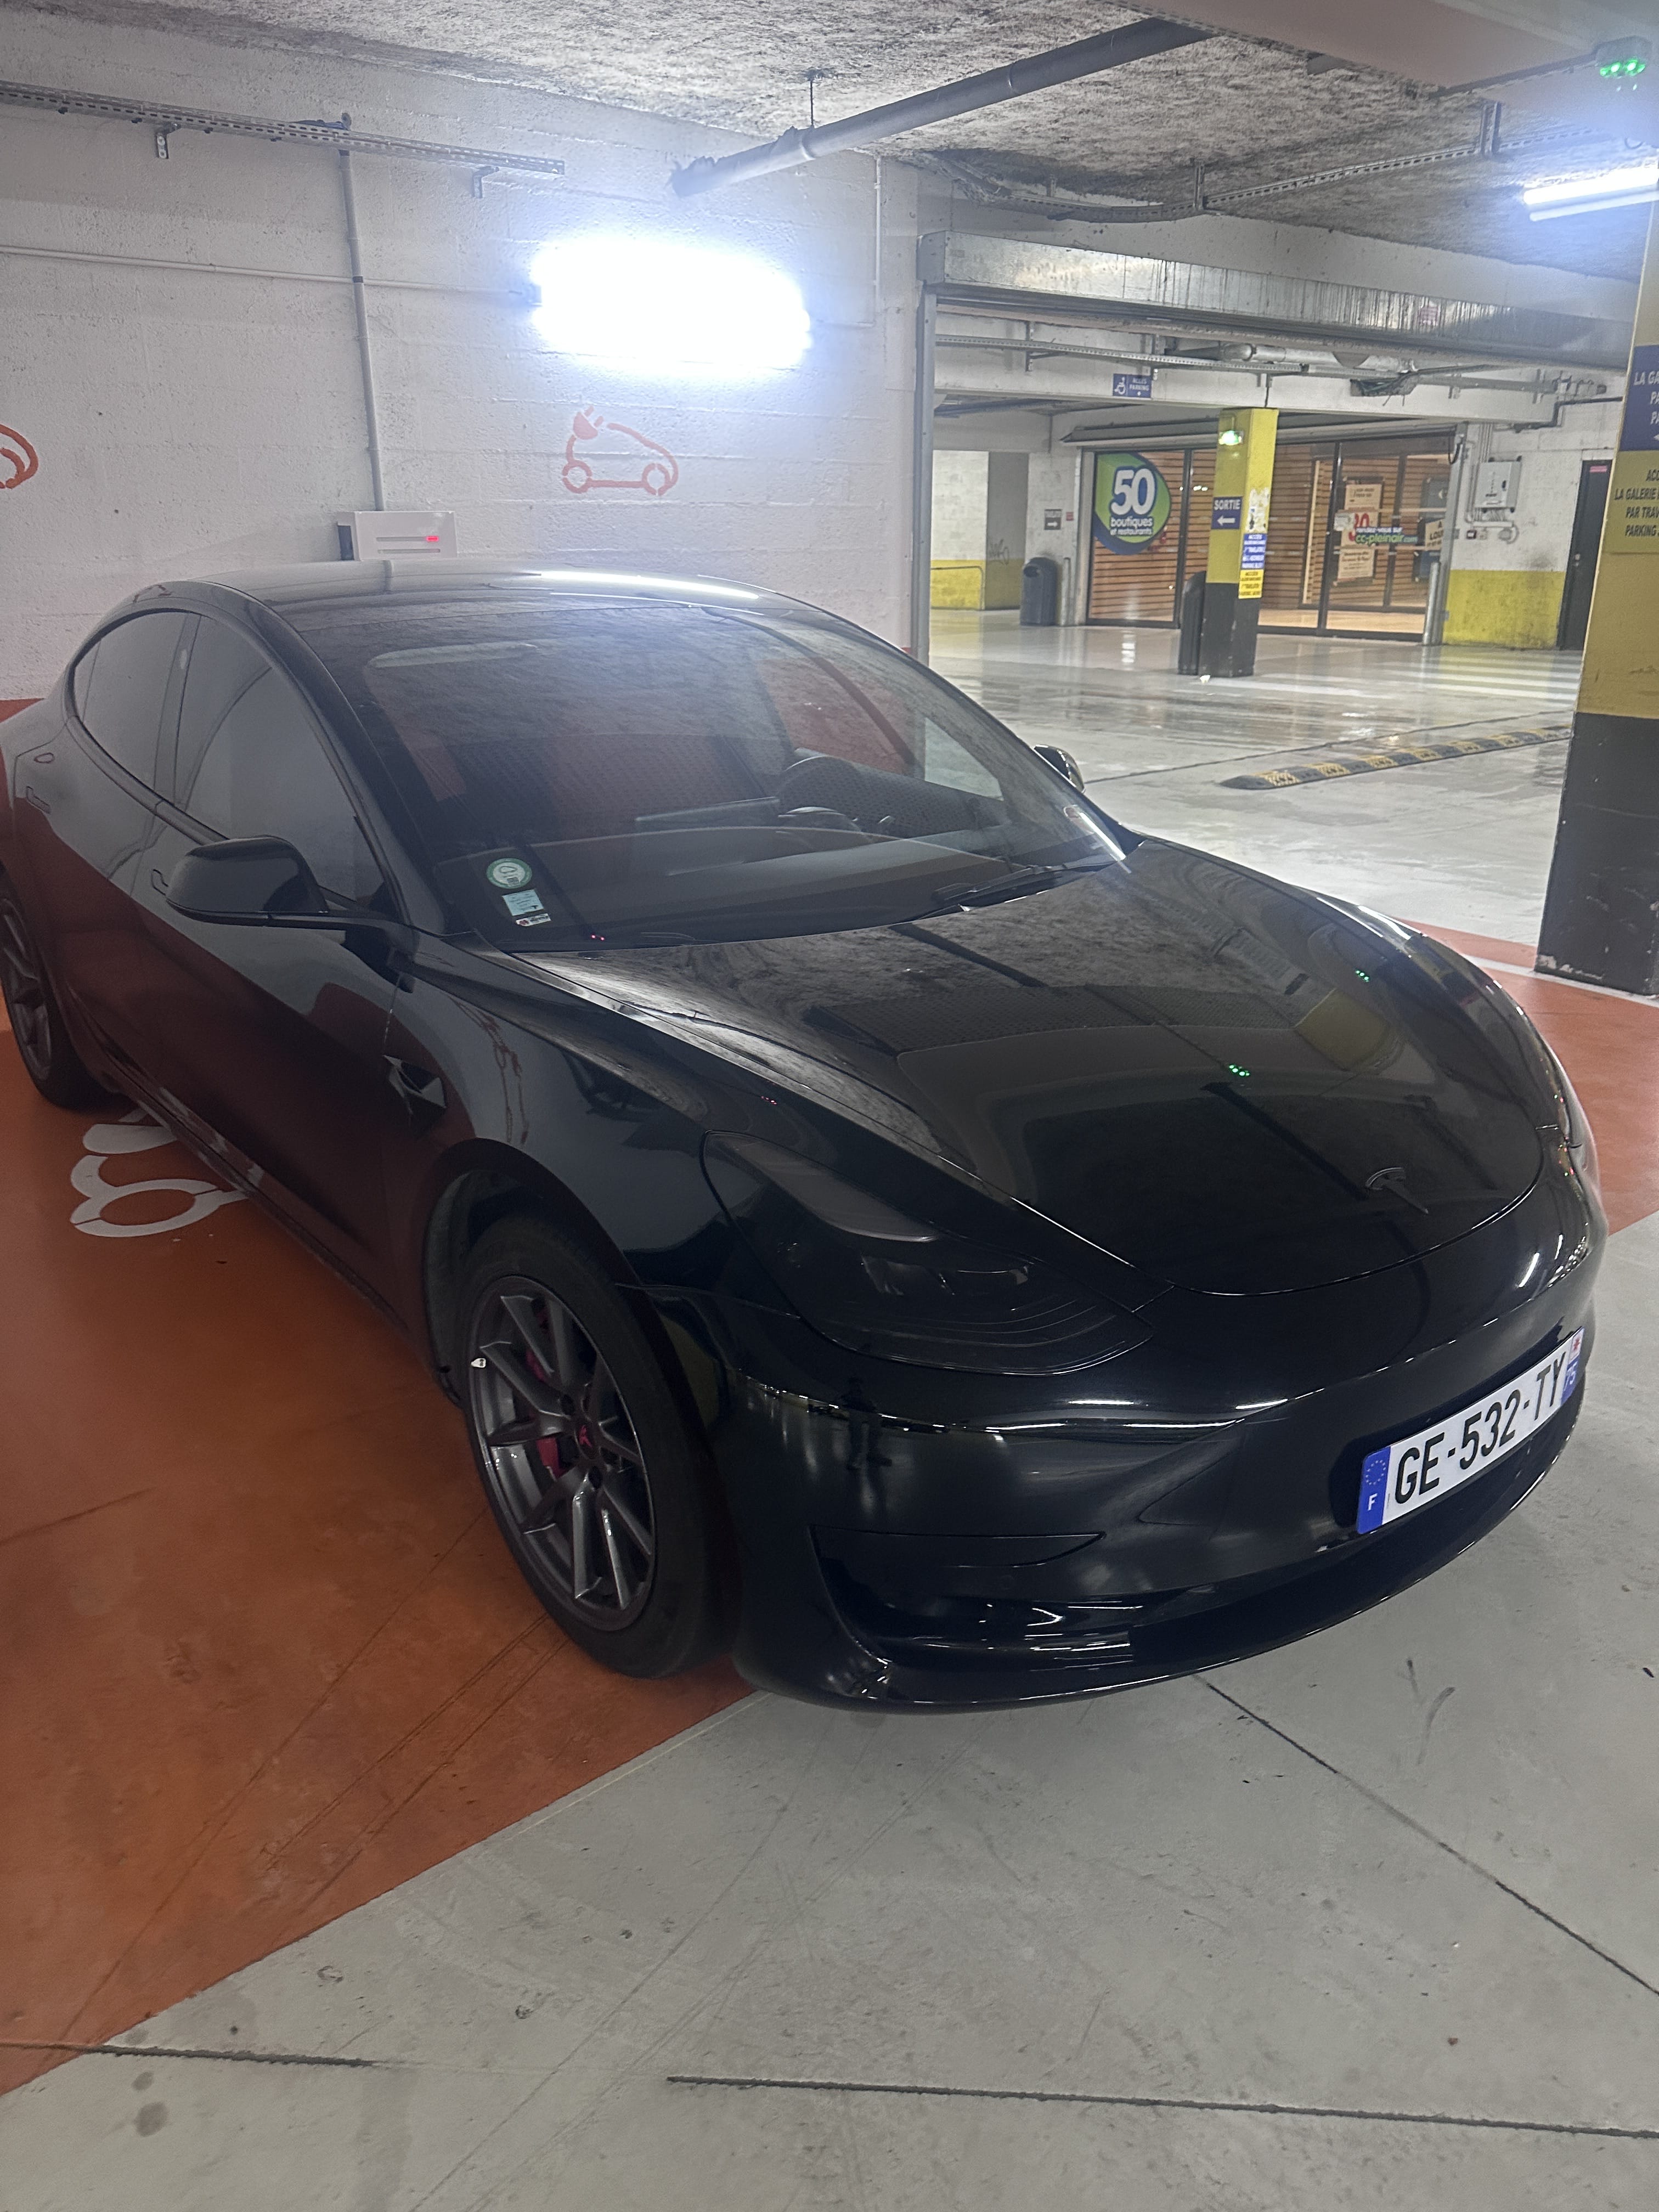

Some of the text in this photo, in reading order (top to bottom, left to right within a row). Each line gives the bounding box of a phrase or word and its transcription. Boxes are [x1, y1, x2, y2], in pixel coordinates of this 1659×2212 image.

[1634, 371, 1645, 385] LA
[1111, 468, 1155, 515] 50
[1615, 488, 1624, 500] LA
[1626, 487, 1657, 500] GALERIE
[1214, 499, 1241, 510] SORTIE
[1626, 506, 1640, 518] PAR
[1110, 516, 1153, 529] boutiques
[1625, 524, 1656, 537] PARKING
[1368, 1493, 1378, 1511] F
[1395, 1351, 1566, 1504] GE-532-TY
